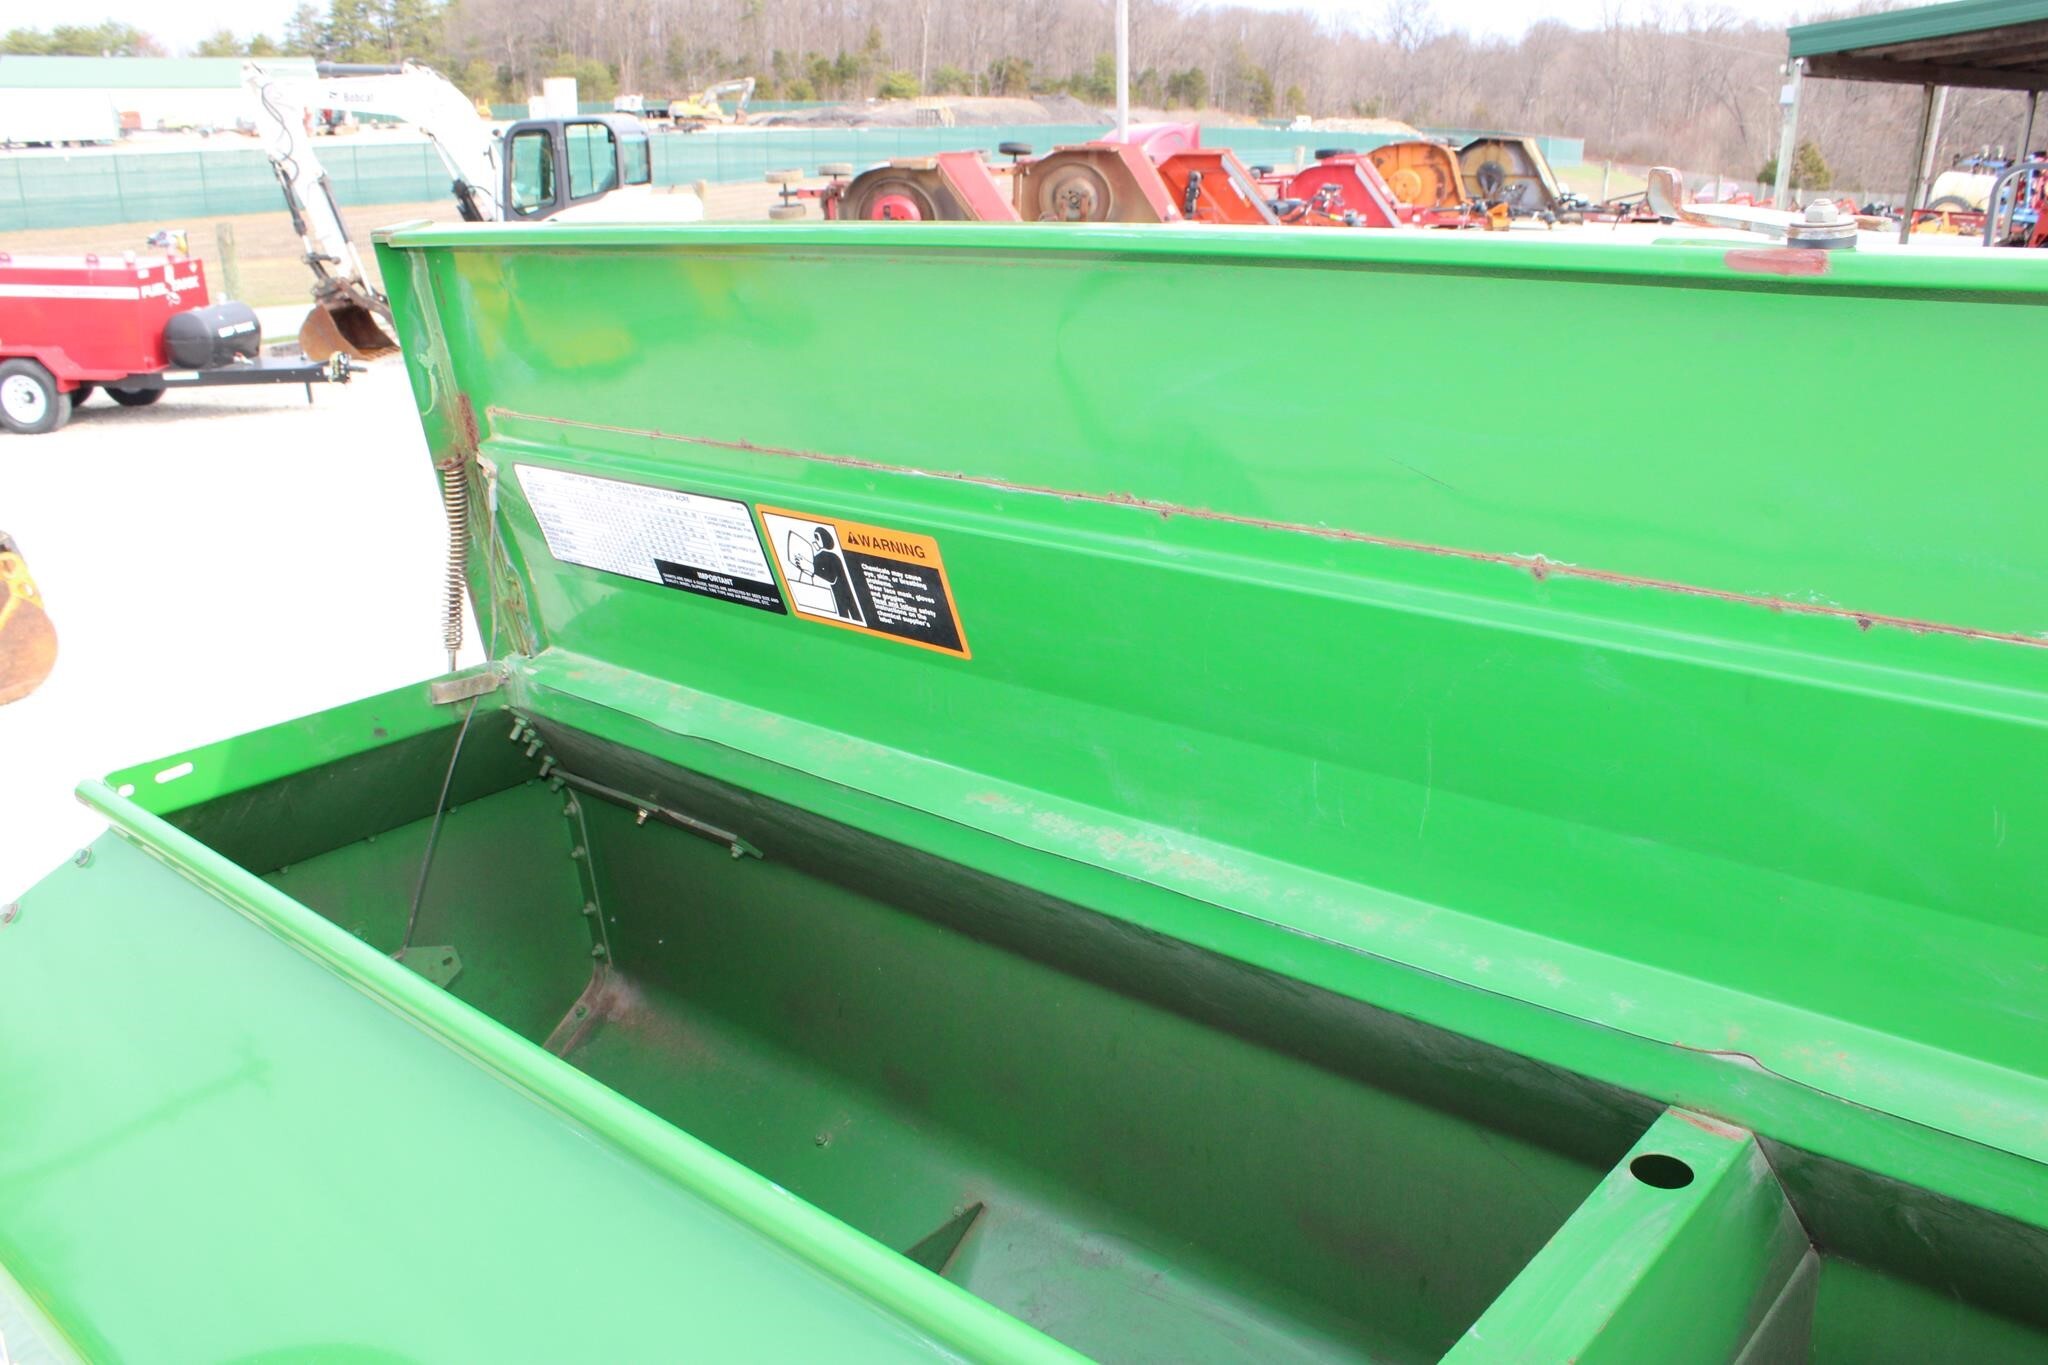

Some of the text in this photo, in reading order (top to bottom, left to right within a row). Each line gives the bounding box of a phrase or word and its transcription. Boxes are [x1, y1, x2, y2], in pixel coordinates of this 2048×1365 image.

[343, 91, 374, 102] Bobcat
[857, 534, 926, 559] WARNING
[697, 572, 734, 585] IMPORTANT
[905, 574, 922, 582] cause
[916, 595, 935, 604] gloves
[918, 608, 936, 618] safety
